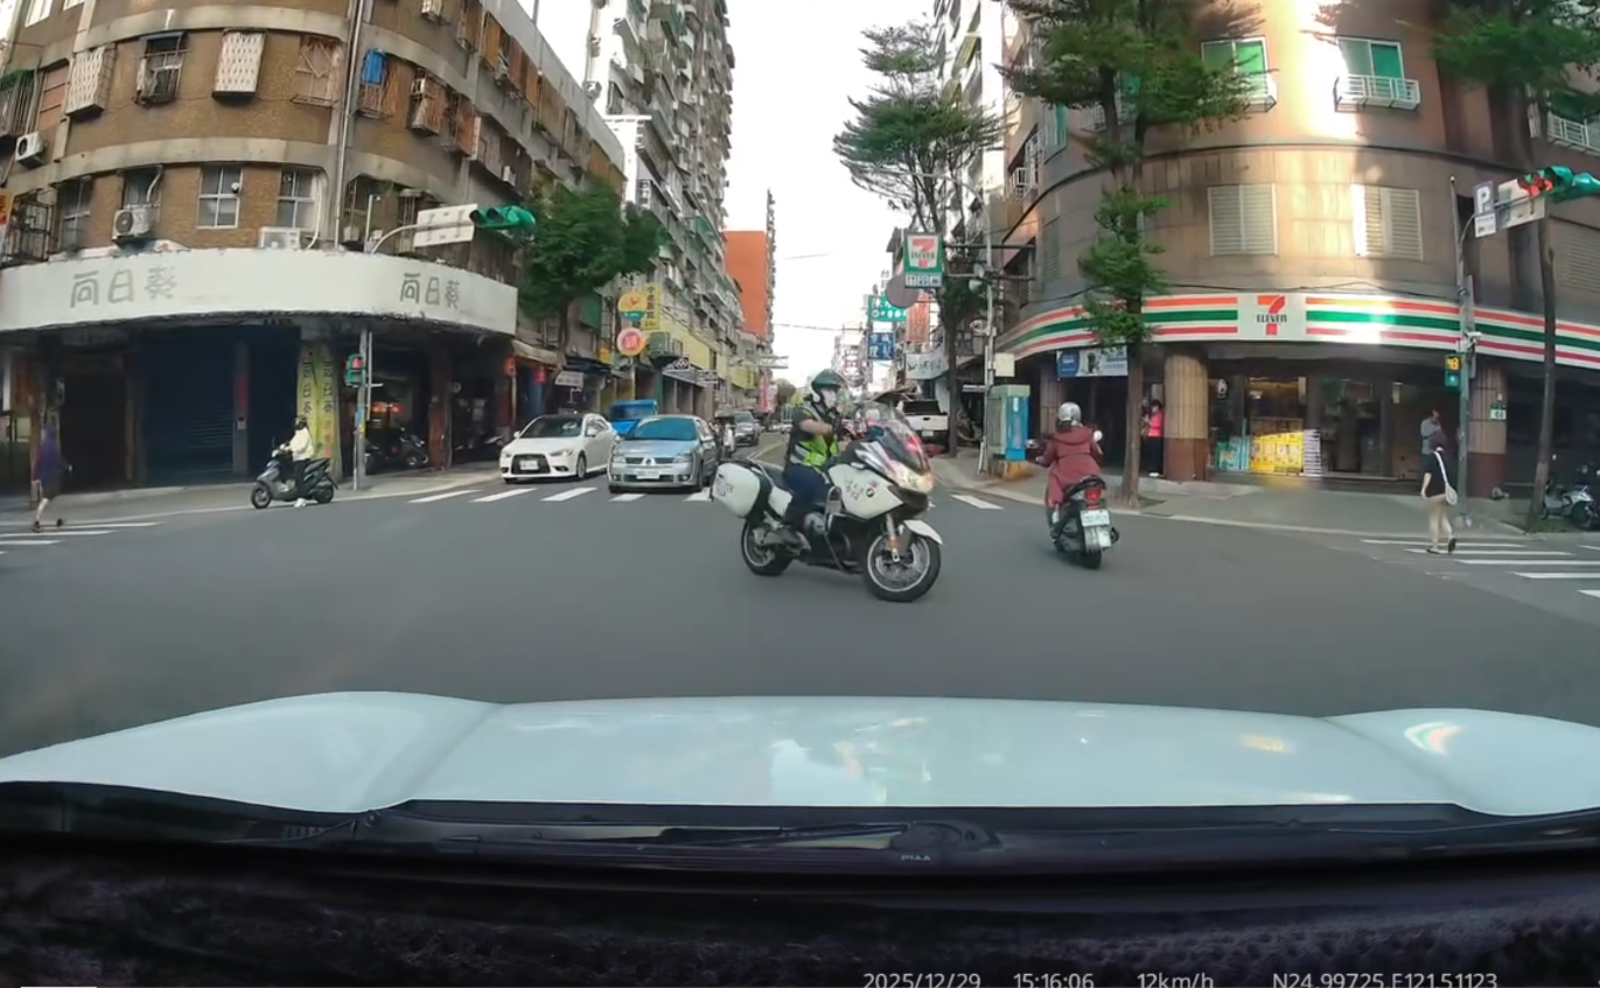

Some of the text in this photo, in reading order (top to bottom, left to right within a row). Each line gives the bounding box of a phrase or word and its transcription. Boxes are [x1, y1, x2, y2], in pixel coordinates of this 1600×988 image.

[912, 238, 935, 267] 7
[70, 266, 177, 308] 向日葵
[399, 272, 460, 309] 向日葵
[1257, 294, 1285, 335] 7
